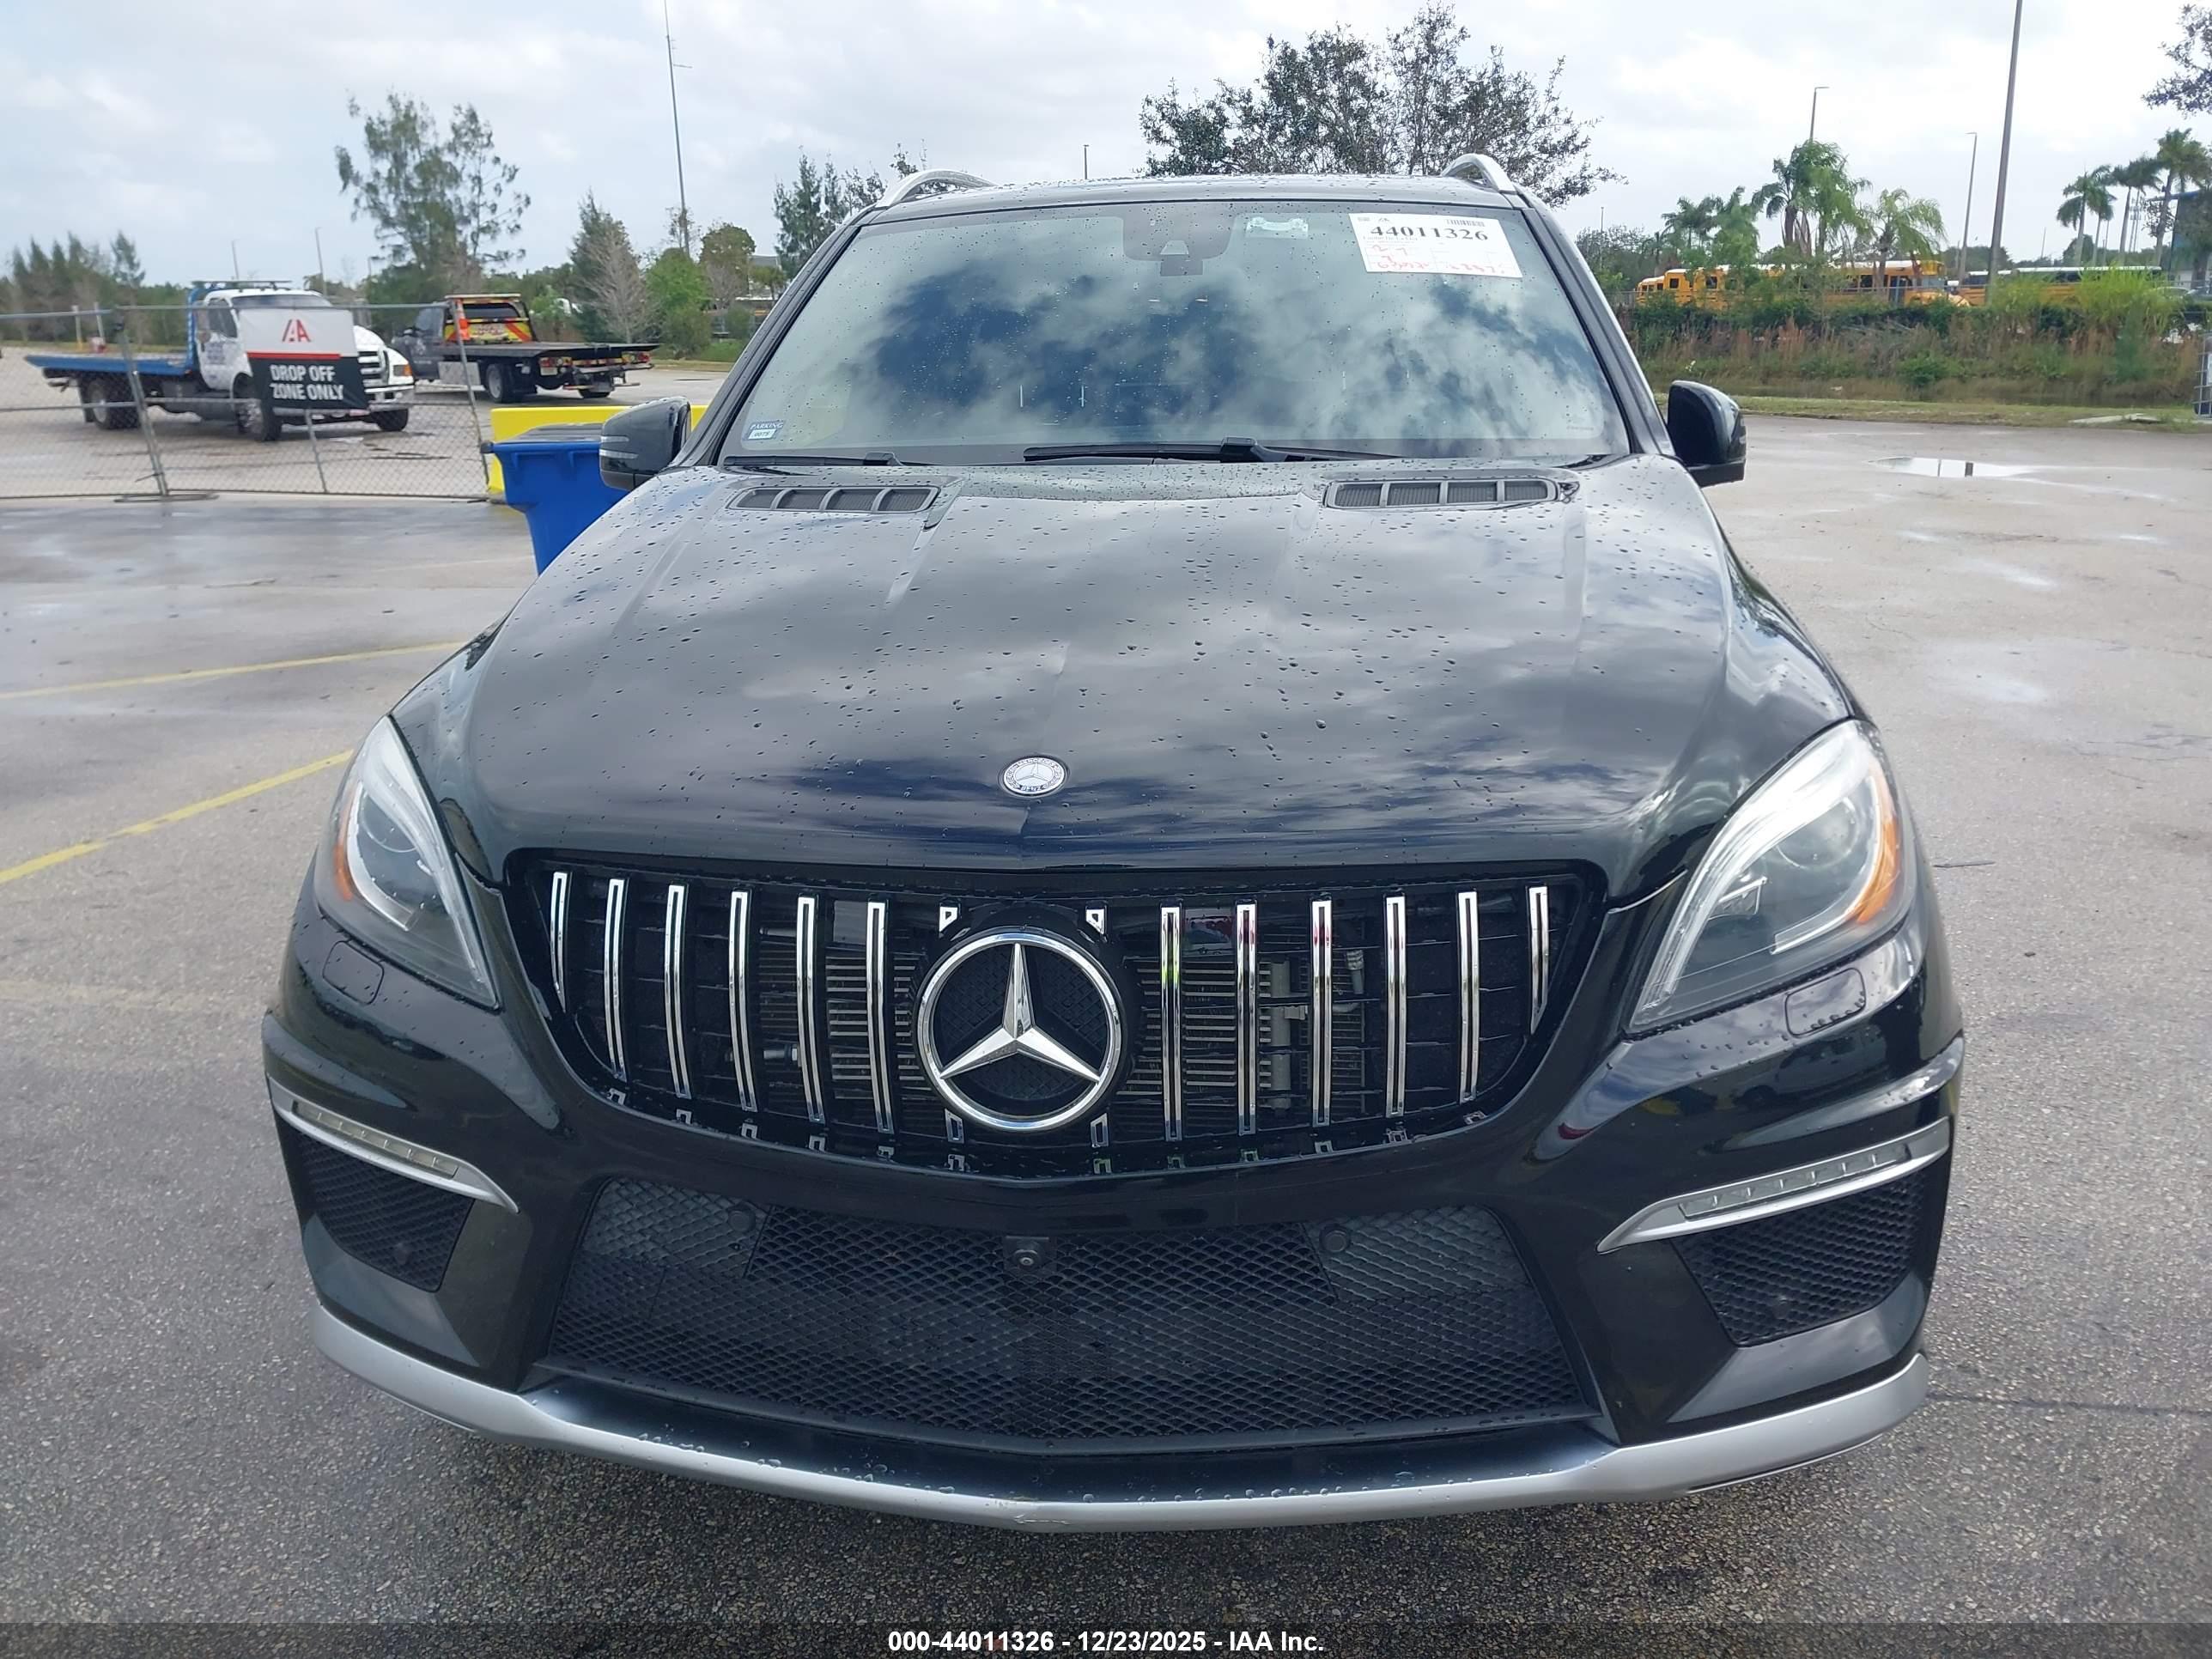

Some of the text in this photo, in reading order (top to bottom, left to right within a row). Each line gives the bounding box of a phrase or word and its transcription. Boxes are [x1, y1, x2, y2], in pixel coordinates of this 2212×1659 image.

[1370, 226, 1488, 241] 44011326
[270, 364, 336, 382] DROP OFF
[270, 383, 344, 400] ZONE ONLY
